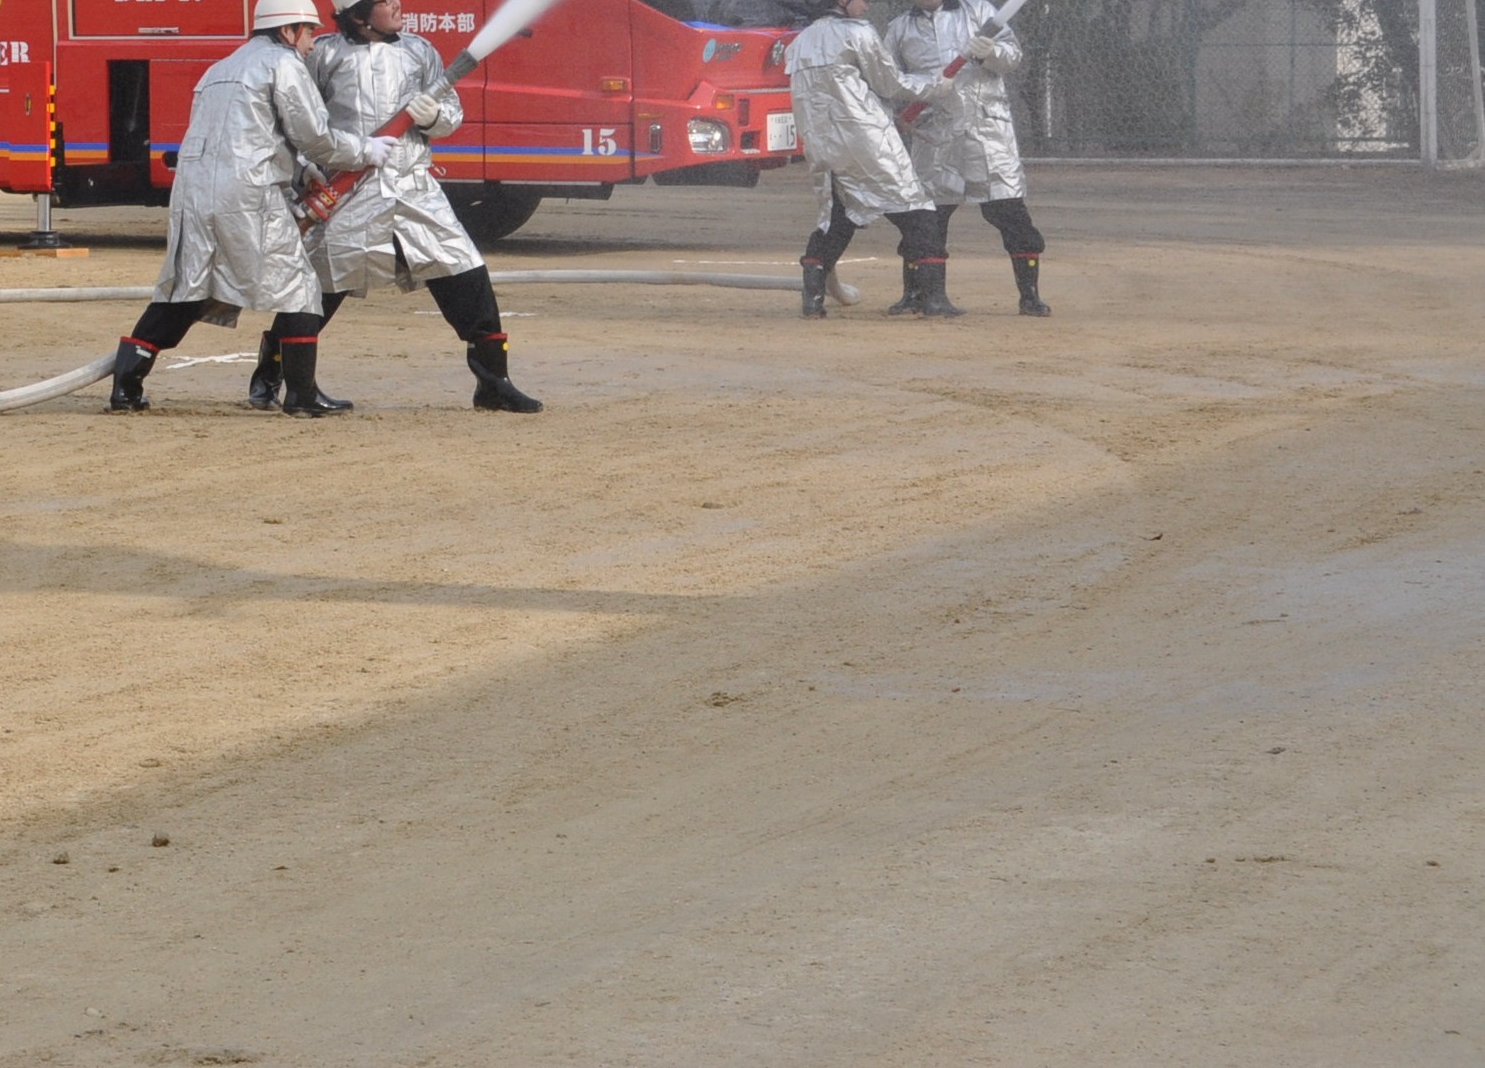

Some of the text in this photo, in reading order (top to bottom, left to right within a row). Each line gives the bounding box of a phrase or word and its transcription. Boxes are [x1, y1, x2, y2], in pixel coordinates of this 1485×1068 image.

[402, 12, 476, 33] 消防本部
[582, 128, 617, 156] 15
